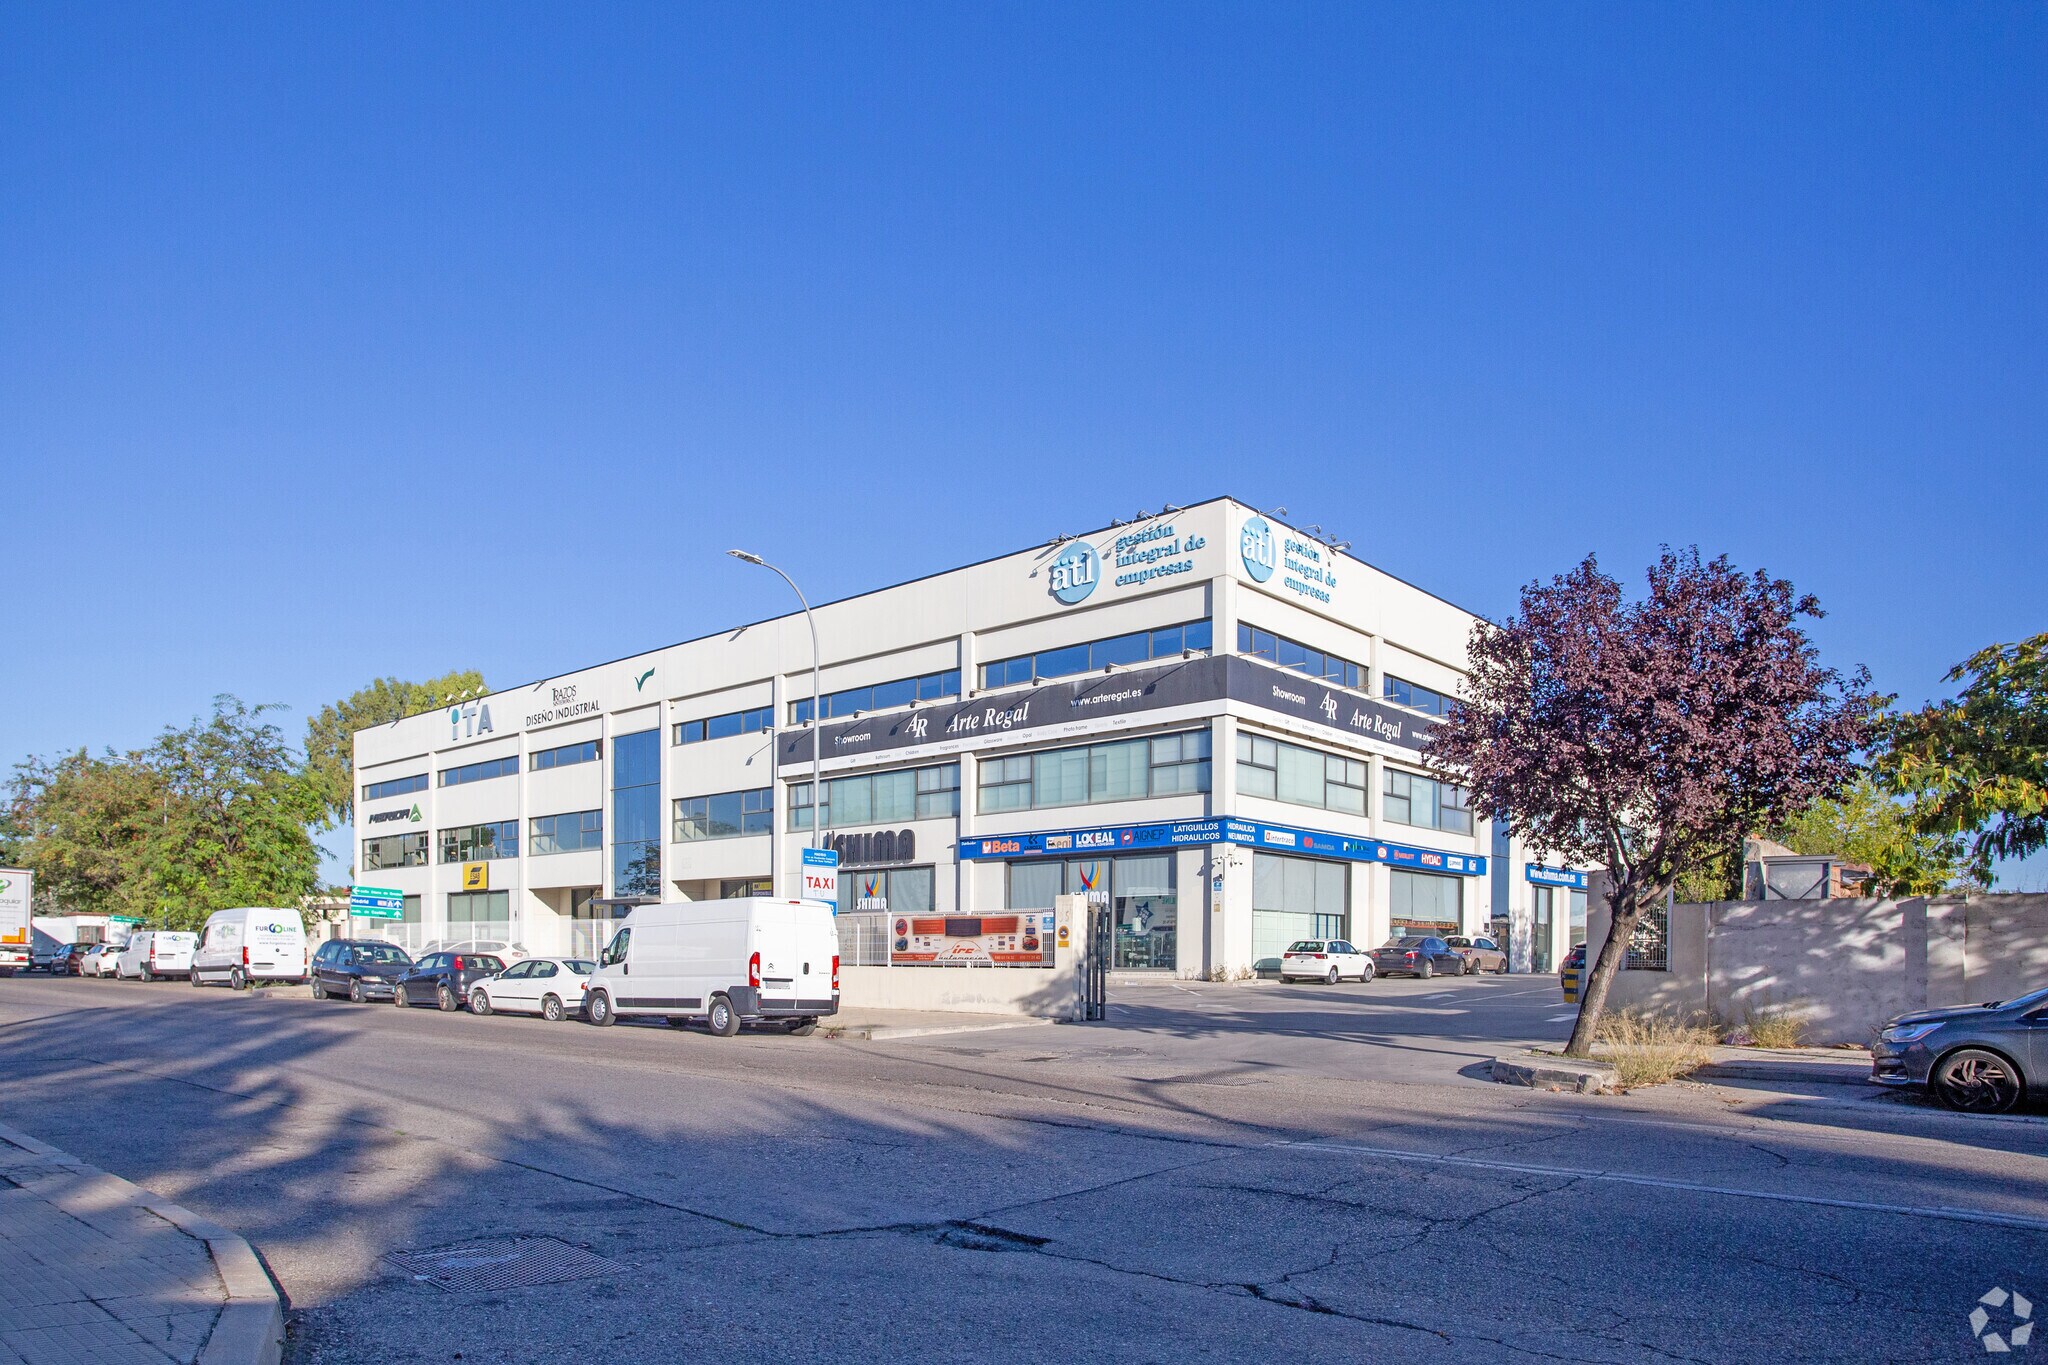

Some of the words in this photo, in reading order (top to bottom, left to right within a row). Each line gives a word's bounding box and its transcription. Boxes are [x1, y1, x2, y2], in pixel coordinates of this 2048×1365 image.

[1115, 524, 1174, 552] gestión
[1115, 538, 1181, 568] integral
[1184, 533, 1206, 552] de
[1284, 539, 1320, 563] gestión
[1115, 558, 1193, 587] empresas
[1284, 553, 1323, 583] integral
[1325, 571, 1337, 588] de
[1284, 575, 1330, 603] empresas
[552, 685, 577, 701] TRAZOS
[526, 709, 554, 727] DISEÑO
[555, 700, 600, 720] INDUSTRIAL
[834, 732, 871, 746] Showroom
[946, 713, 979, 733] Arte
[983, 701, 1030, 729] Regal
[1070, 688, 1142, 708] www.arteregal.es
[1272, 685, 1306, 705] Showroom
[1350, 708, 1372, 730] Arte
[1374, 714, 1402, 741] Regal
[369, 809, 410, 824] MERIDA
[1173, 822, 1219, 833] LATIGUILLOS
[1227, 822, 1256, 833] HIDRAULICA
[1076, 832, 1115, 845] LOXEAL
[1133, 829, 1165, 841] AIGNEP
[1171, 832, 1220, 843] HIDRAULICOS
[1227, 832, 1255, 843] NEUMATICA
[992, 840, 1020, 853] Beta
[1056, 836, 1072, 849] eni
[1421, 853, 1441, 866] HYDAC
[806, 876, 835, 890] TAXI
[856, 897, 888, 910] SHIMA
